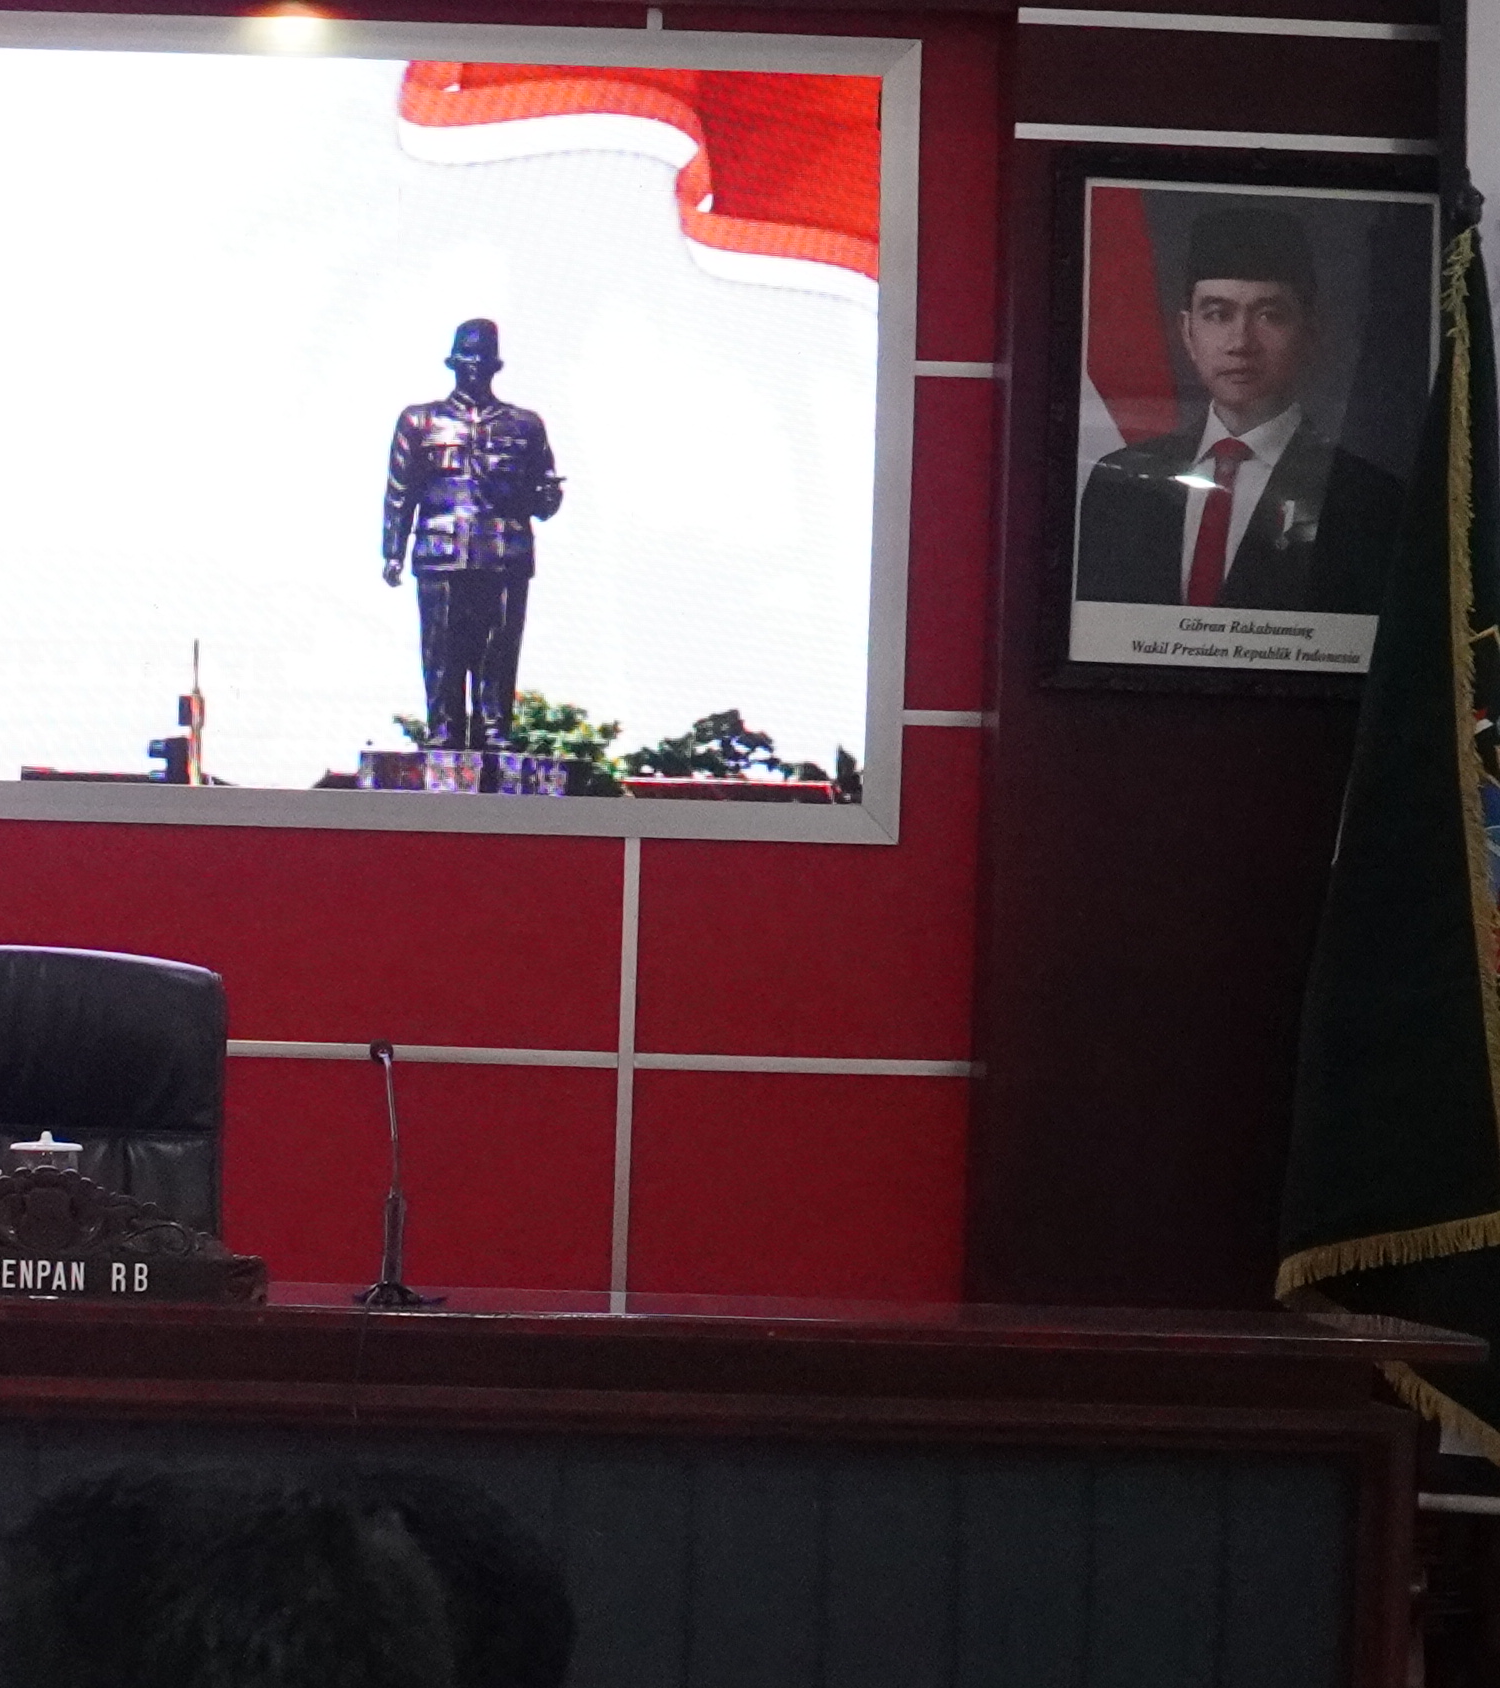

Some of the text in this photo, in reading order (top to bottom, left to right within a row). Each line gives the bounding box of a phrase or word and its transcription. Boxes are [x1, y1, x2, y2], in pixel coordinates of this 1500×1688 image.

[1179, 618, 1226, 633] Gibran
[1132, 639, 1170, 655] Wakil
[1171, 642, 1229, 658] Presiden
[1233, 645, 1292, 662] Republik
